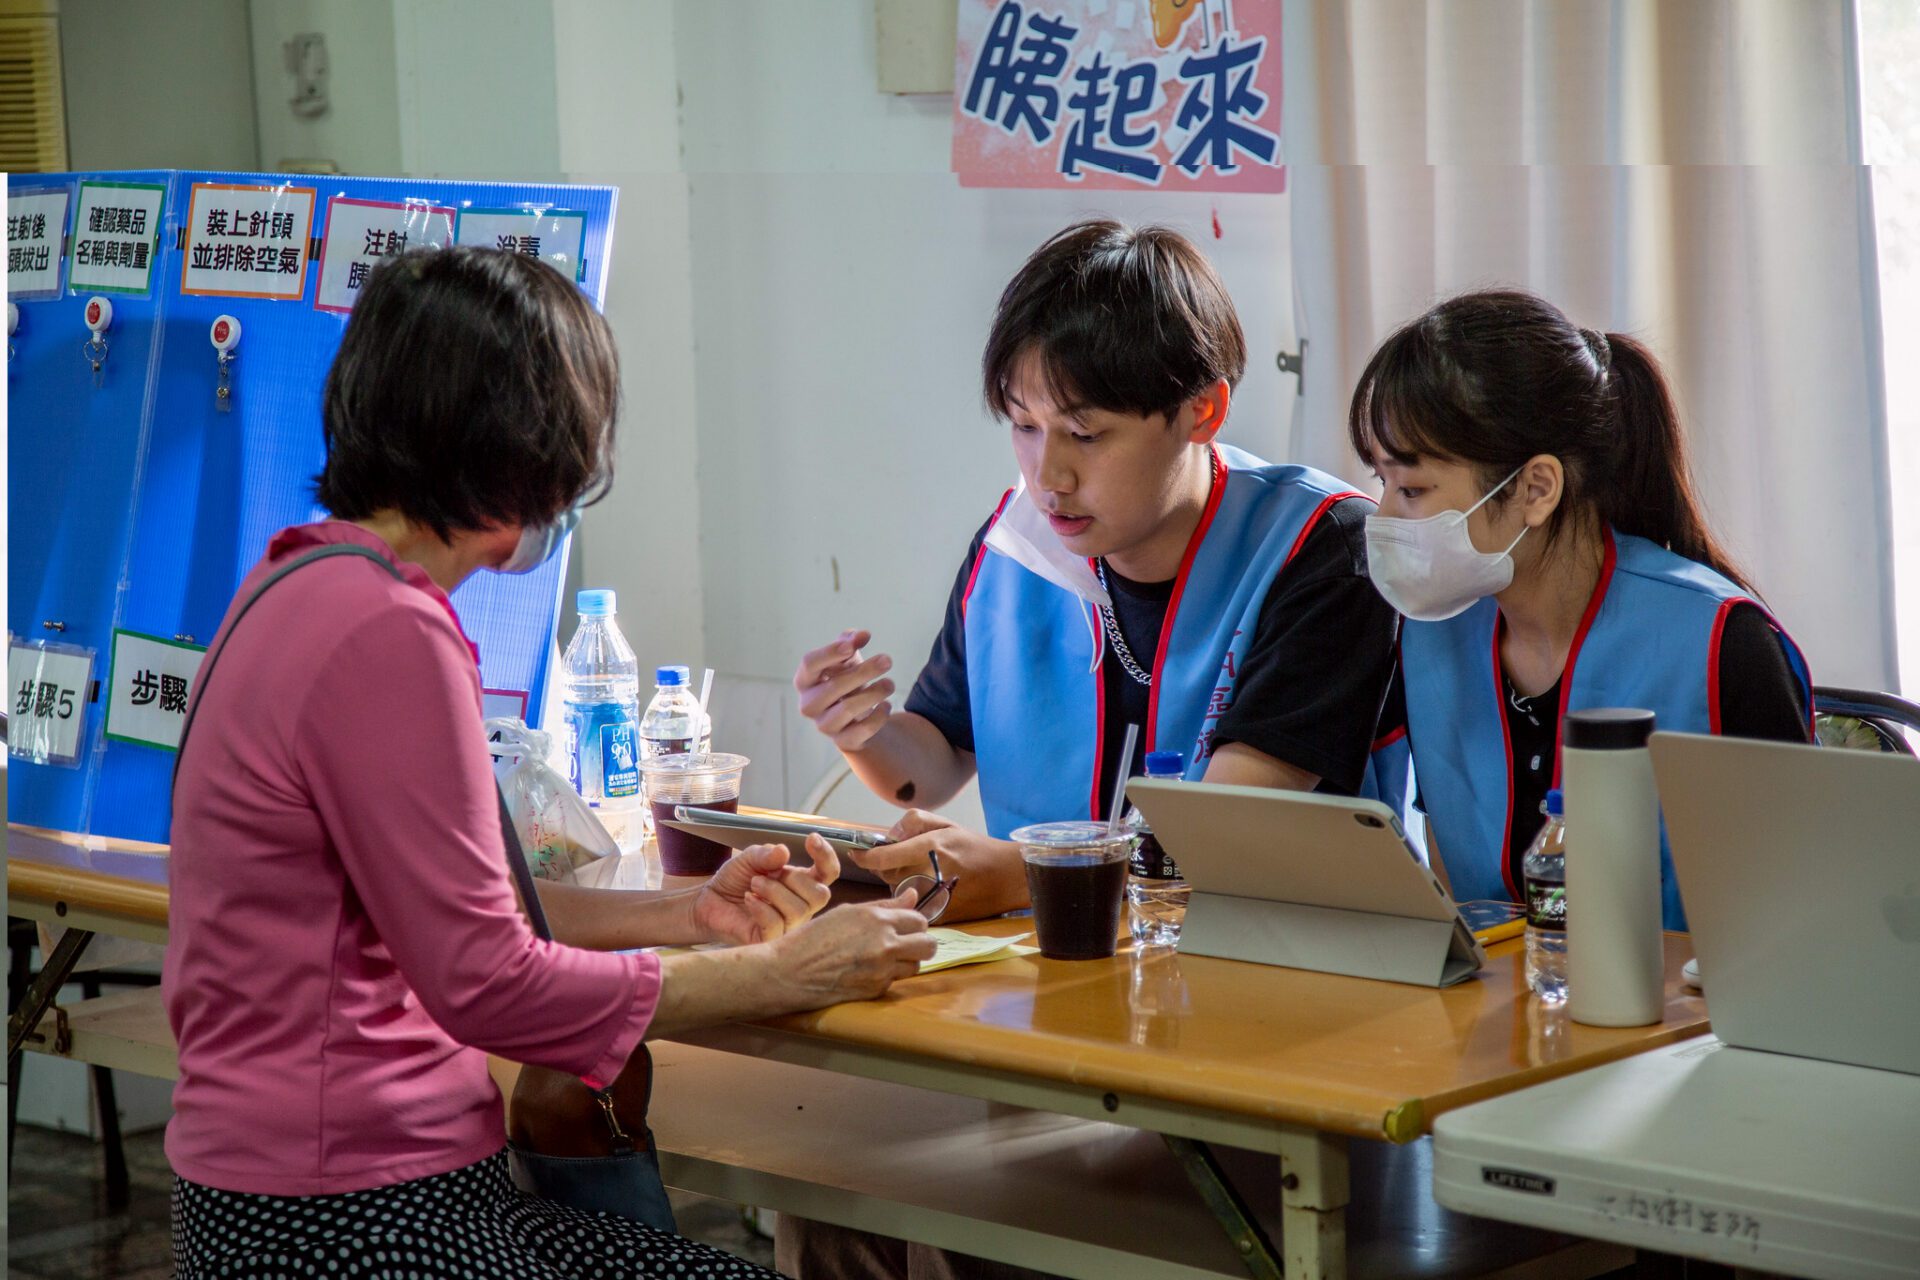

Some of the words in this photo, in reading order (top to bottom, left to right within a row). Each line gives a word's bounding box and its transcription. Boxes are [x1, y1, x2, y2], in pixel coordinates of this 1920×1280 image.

[964, 0, 1276, 181] 胰起來
[89, 206, 147, 235] 確認藥品
[206, 208, 294, 239] 裝上針頭
[76, 239, 149, 269] 名稱與劑量
[191, 242, 301, 274] 並排除空氣
[16, 679, 75, 719] 步驟5
